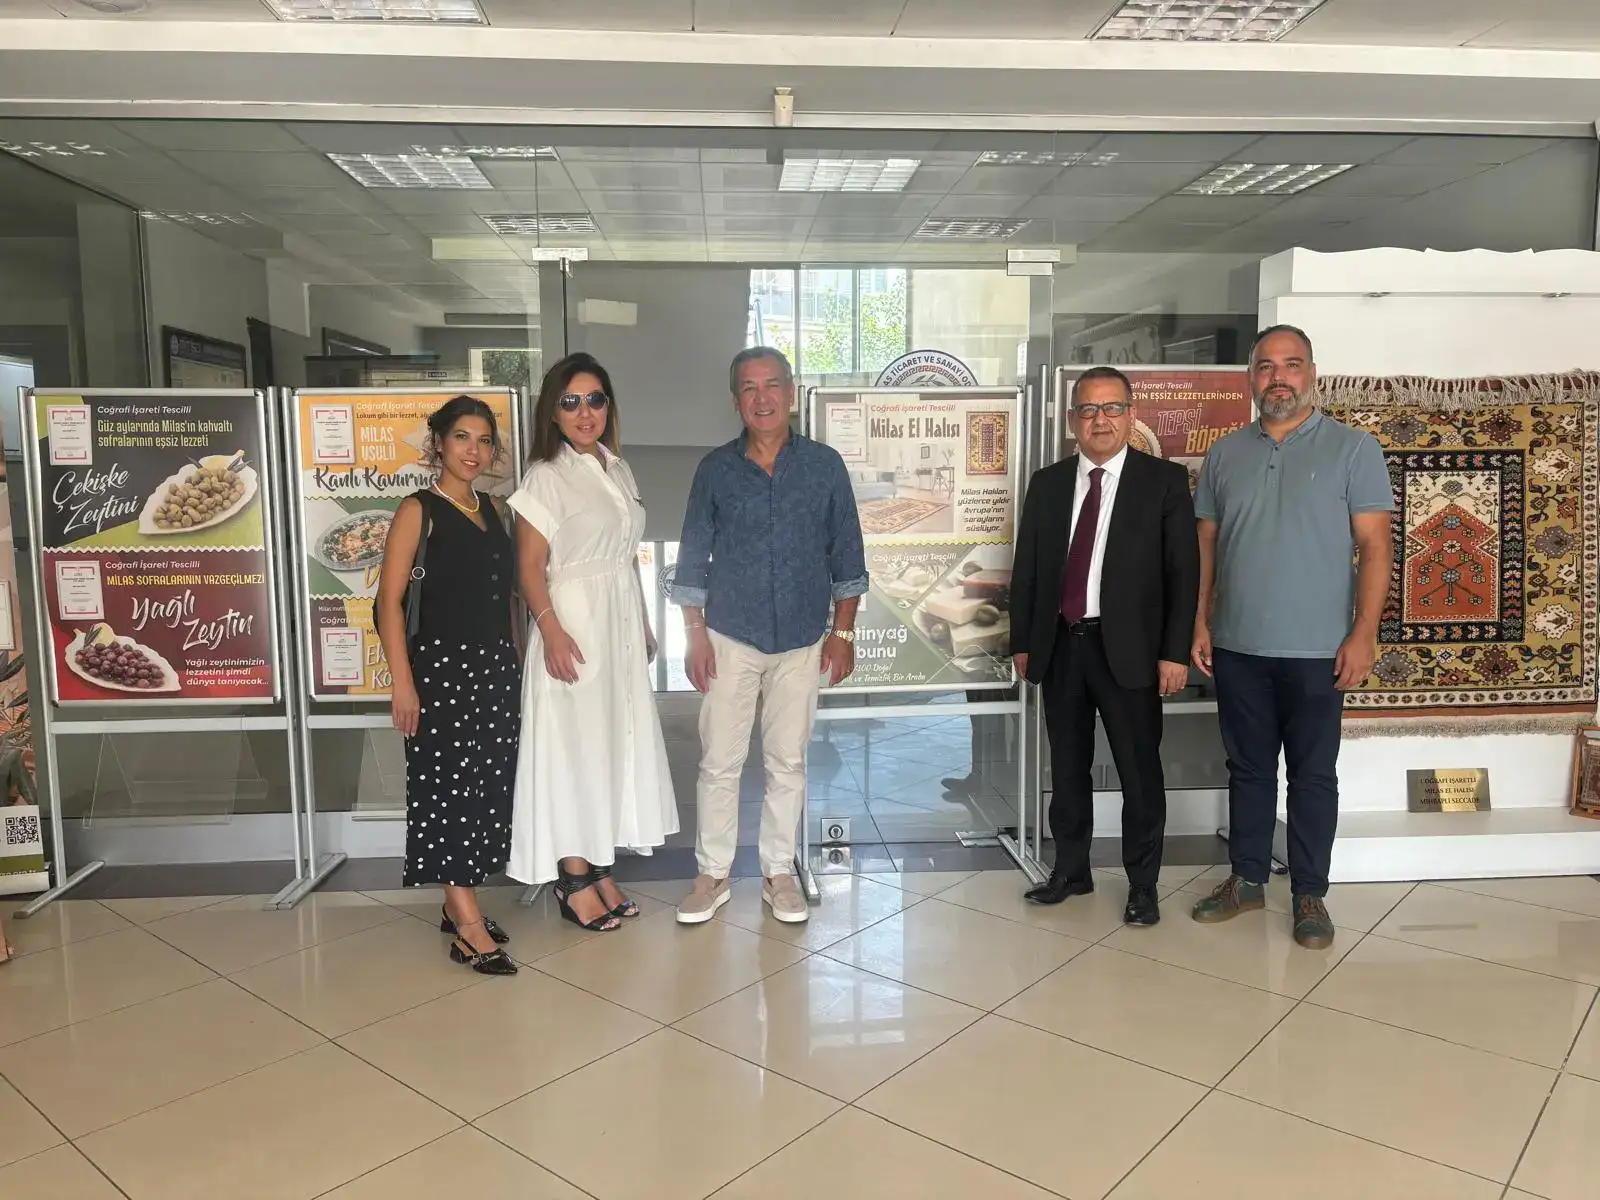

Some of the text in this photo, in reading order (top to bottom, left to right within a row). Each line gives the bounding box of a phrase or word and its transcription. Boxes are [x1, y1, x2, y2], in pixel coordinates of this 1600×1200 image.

[891, 356, 922, 376] TİCARET
[924, 356, 936, 364] VE
[1132, 390, 1243, 402] S'IN EŞSİZ LEZZETLERİNDEN
[97, 405, 192, 415] Coğrafi İşareti Tescilli
[97, 420, 233, 434] Güz aylarında Milas'ın kahvaltı
[870, 418, 904, 438] Milas
[908, 417, 920, 438] El
[925, 417, 960, 438] Halısı
[1157, 403, 1203, 436] TEPSİ
[360, 424, 395, 442] MİLAS
[98, 435, 209, 449] sofralarının eşsiz lezzeti
[361, 443, 396, 461] USULÜ
[313, 465, 361, 492] Kanlı
[52, 463, 130, 513] Çekişke
[64, 494, 140, 535] Zeytini
[105, 559, 200, 571] Coğrafi İşareti Tescilli
[106, 572, 265, 587] MİLAS SOFRALARININ VAZGEÇİLMEZİ
[131, 589, 196, 631] Yağlı
[182, 608, 254, 651] Zeytin
[856, 646, 897, 659] bunu
[185, 657, 265, 668] Yağlı zeytinimizin
[186, 668, 251, 676] lezzetini şimdi
[186, 678, 216, 687] dünya
